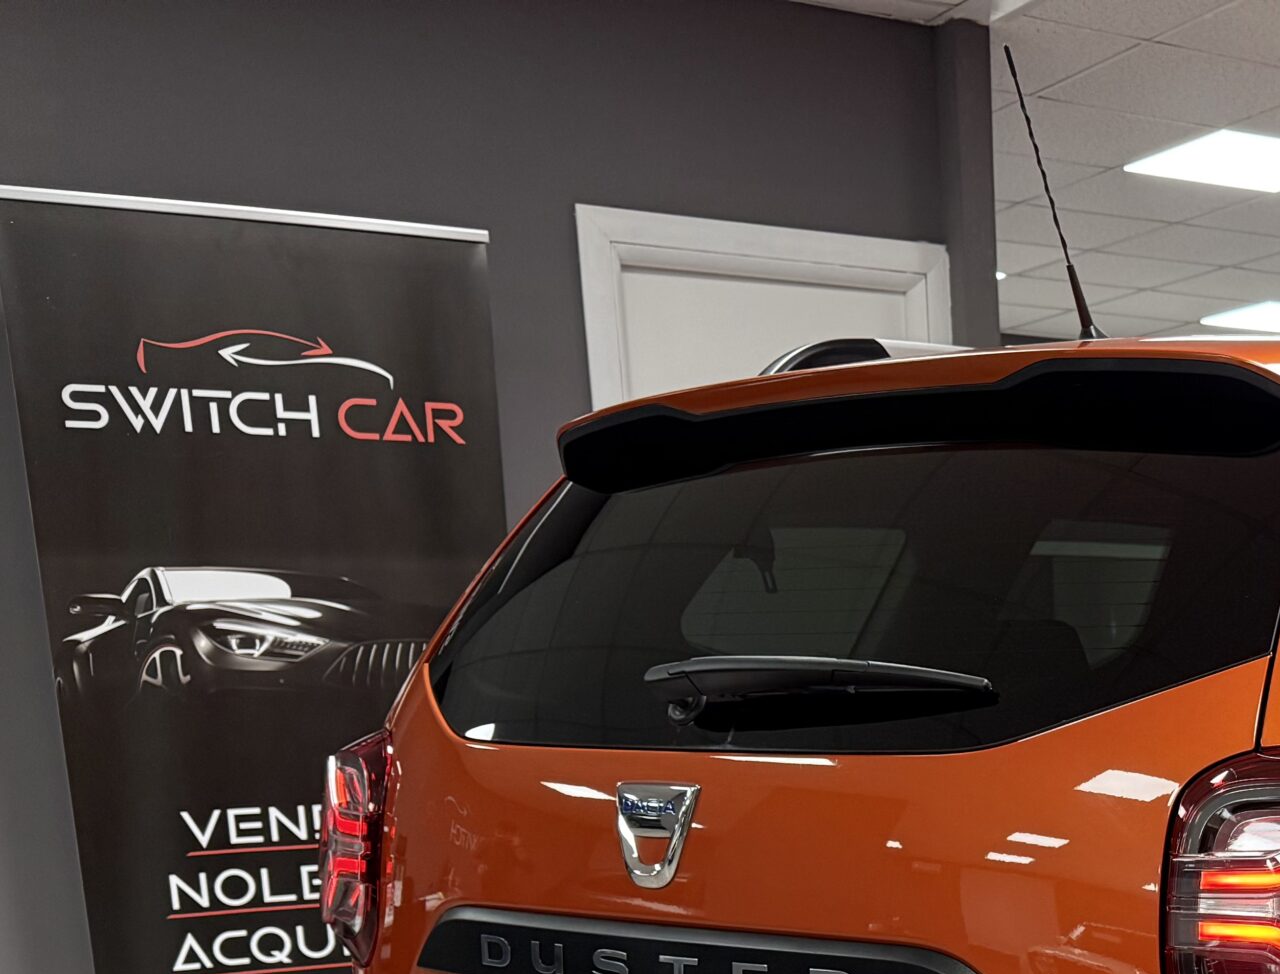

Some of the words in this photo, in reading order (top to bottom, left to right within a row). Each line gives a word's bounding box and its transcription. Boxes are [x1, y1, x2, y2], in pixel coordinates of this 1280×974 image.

[60, 383, 321, 439] SWITCH
[337, 397, 466, 445] CAR
[179, 804, 322, 849] VEN
[172, 923, 351, 972] ACQU
